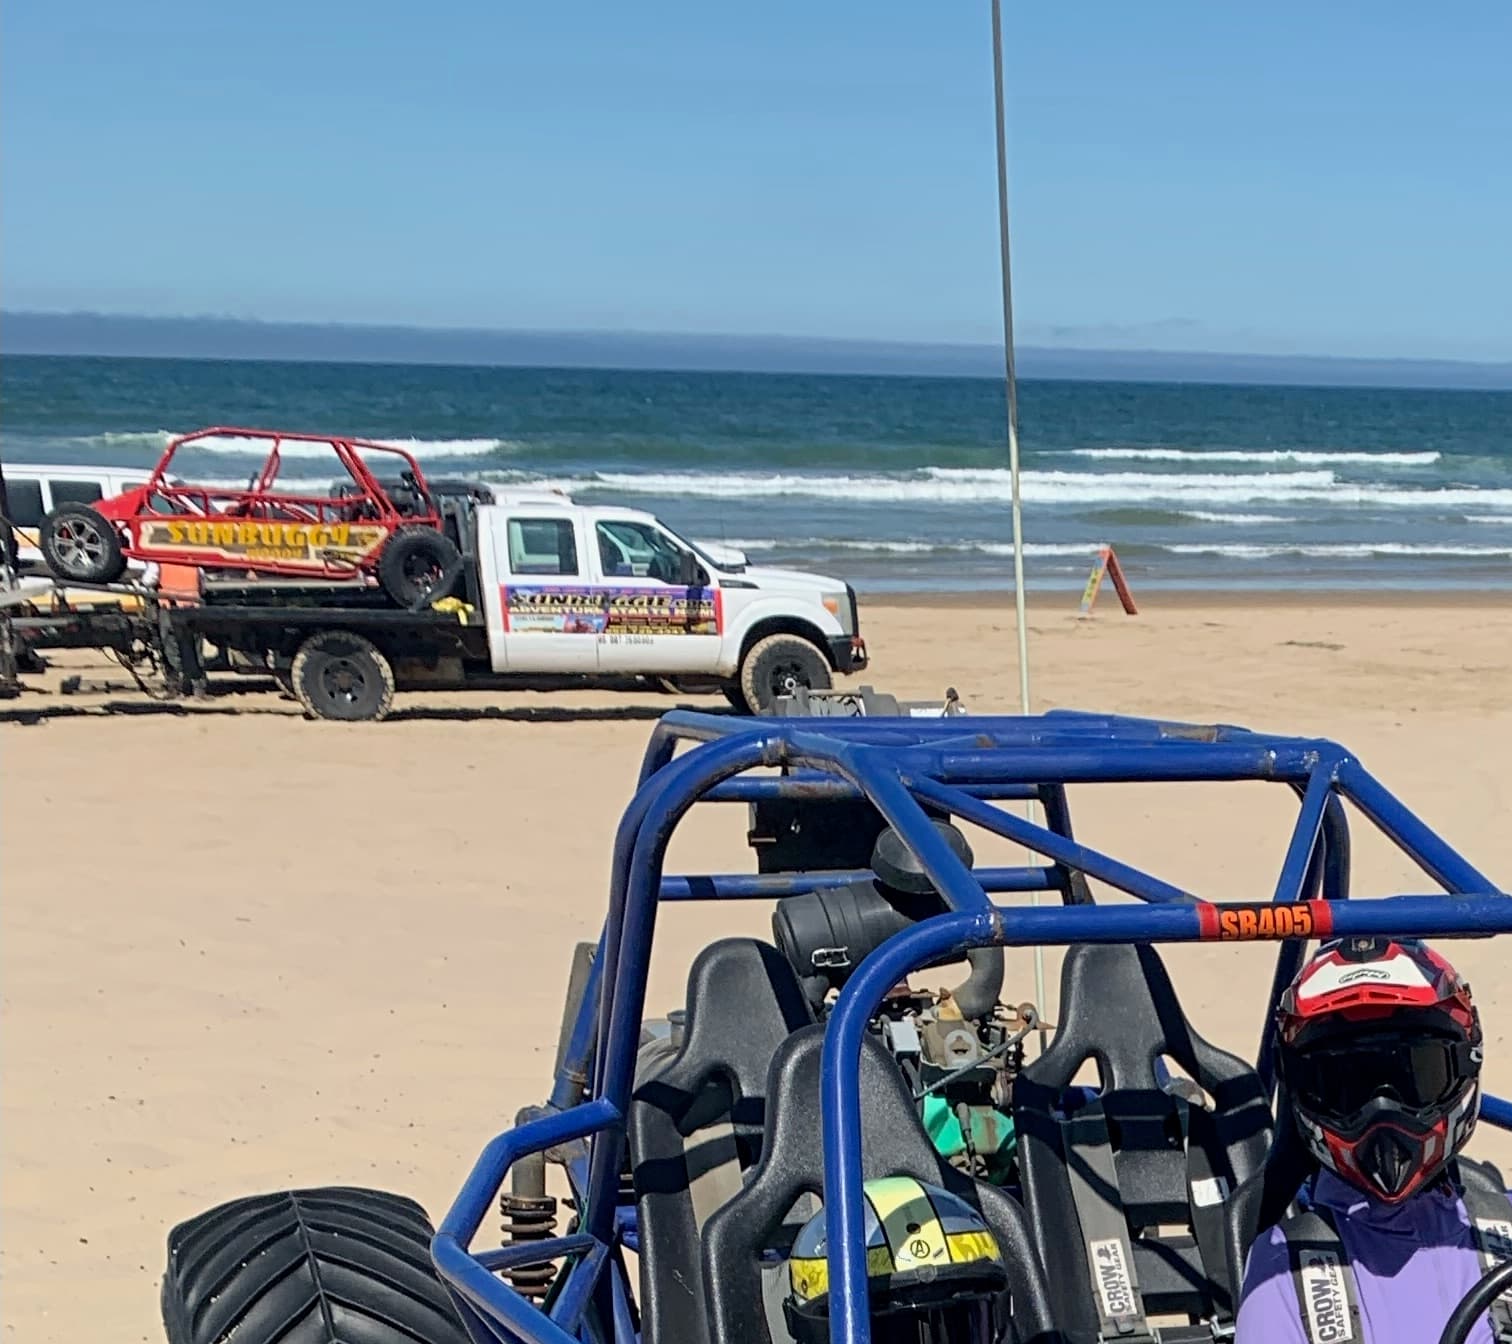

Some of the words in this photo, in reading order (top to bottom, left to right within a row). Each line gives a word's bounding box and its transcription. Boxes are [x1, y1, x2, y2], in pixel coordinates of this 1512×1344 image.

[167, 519, 351, 547] SUNBUGGY
[1220, 904, 1312, 939] SB405
[1100, 1265, 1125, 1313] CROW
[1325, 1256, 1338, 1286] GEAR
[1310, 1279, 1337, 1342] CROW
[1332, 1289, 1346, 1337] SAFETY
